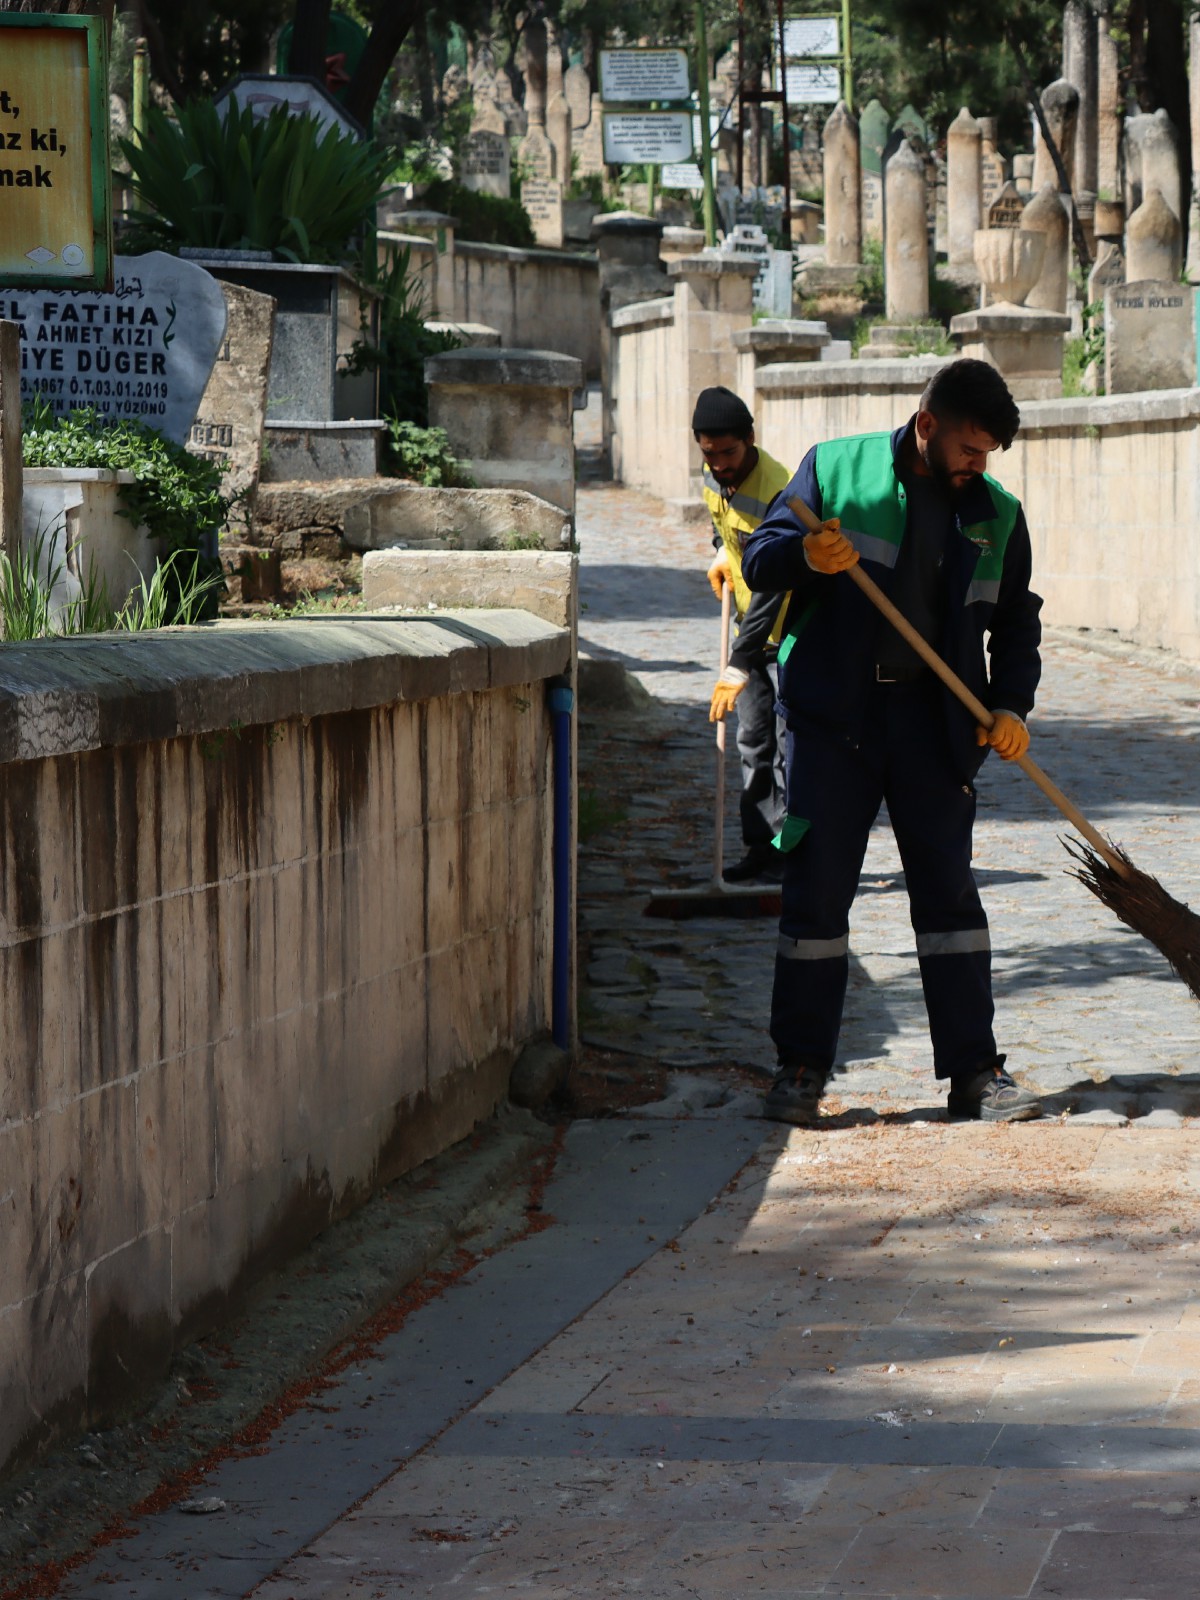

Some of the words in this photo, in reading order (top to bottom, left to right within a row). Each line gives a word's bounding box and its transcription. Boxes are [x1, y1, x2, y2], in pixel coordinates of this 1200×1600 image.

[30, 128, 67, 157] ki,
[37, 325, 104, 345] AHMET
[112, 327, 153, 347] KIZI
[77, 346, 167, 375] DÜGER
[69, 376, 168, 399] Ö.T.03.01.2019
[116, 400, 166, 416] YÜZÜNÜ
